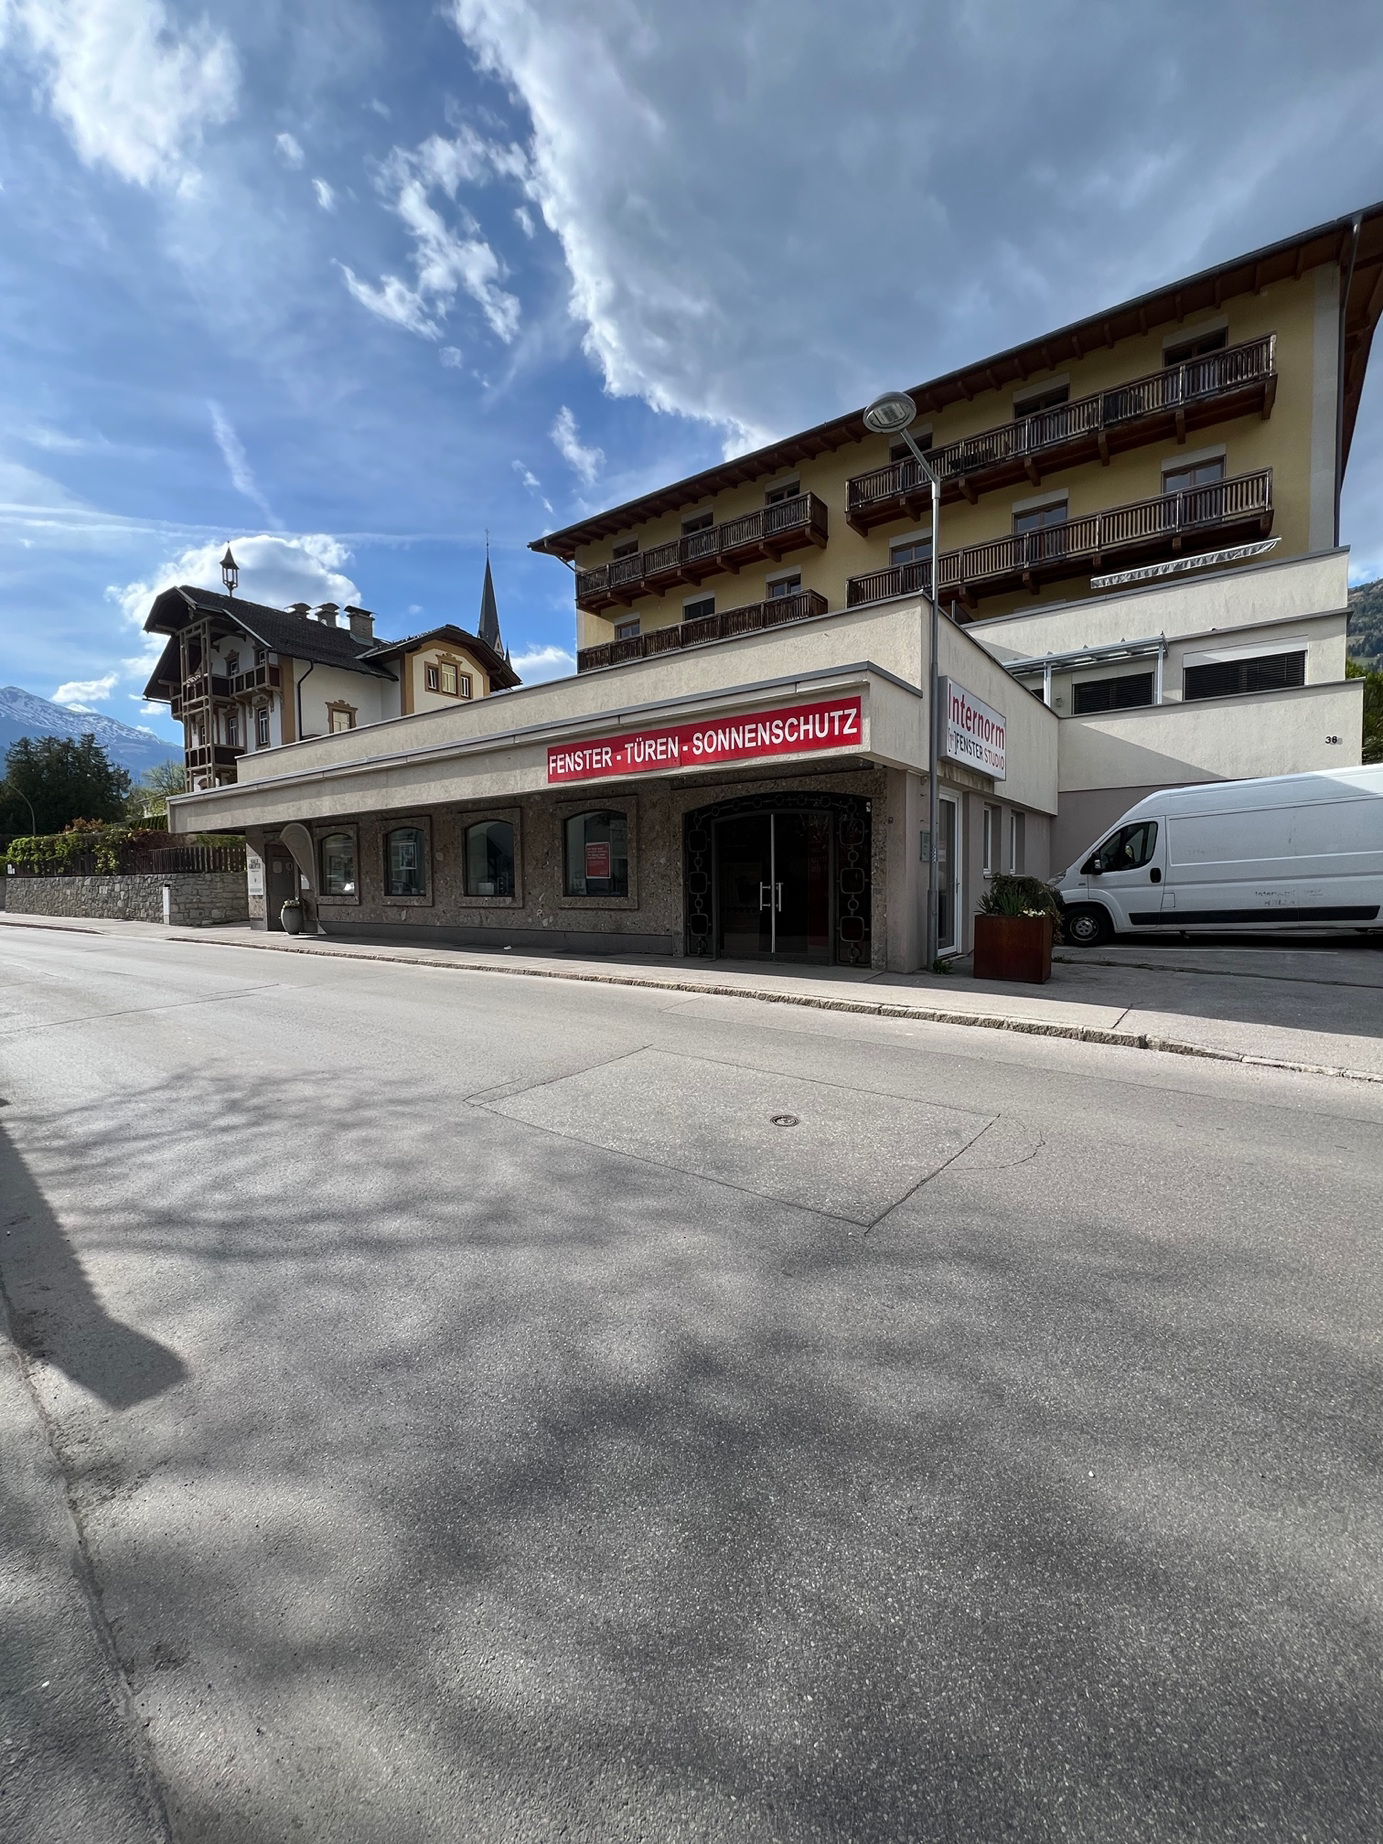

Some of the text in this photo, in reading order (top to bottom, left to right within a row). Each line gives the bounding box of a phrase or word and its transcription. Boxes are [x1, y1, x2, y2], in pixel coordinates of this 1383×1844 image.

[549, 746, 612, 775] FENSTER
[624, 736, 679, 764] TÜREN
[692, 708, 858, 755] SONNENSCHUTZ
[948, 683, 1005, 750] Internorm
